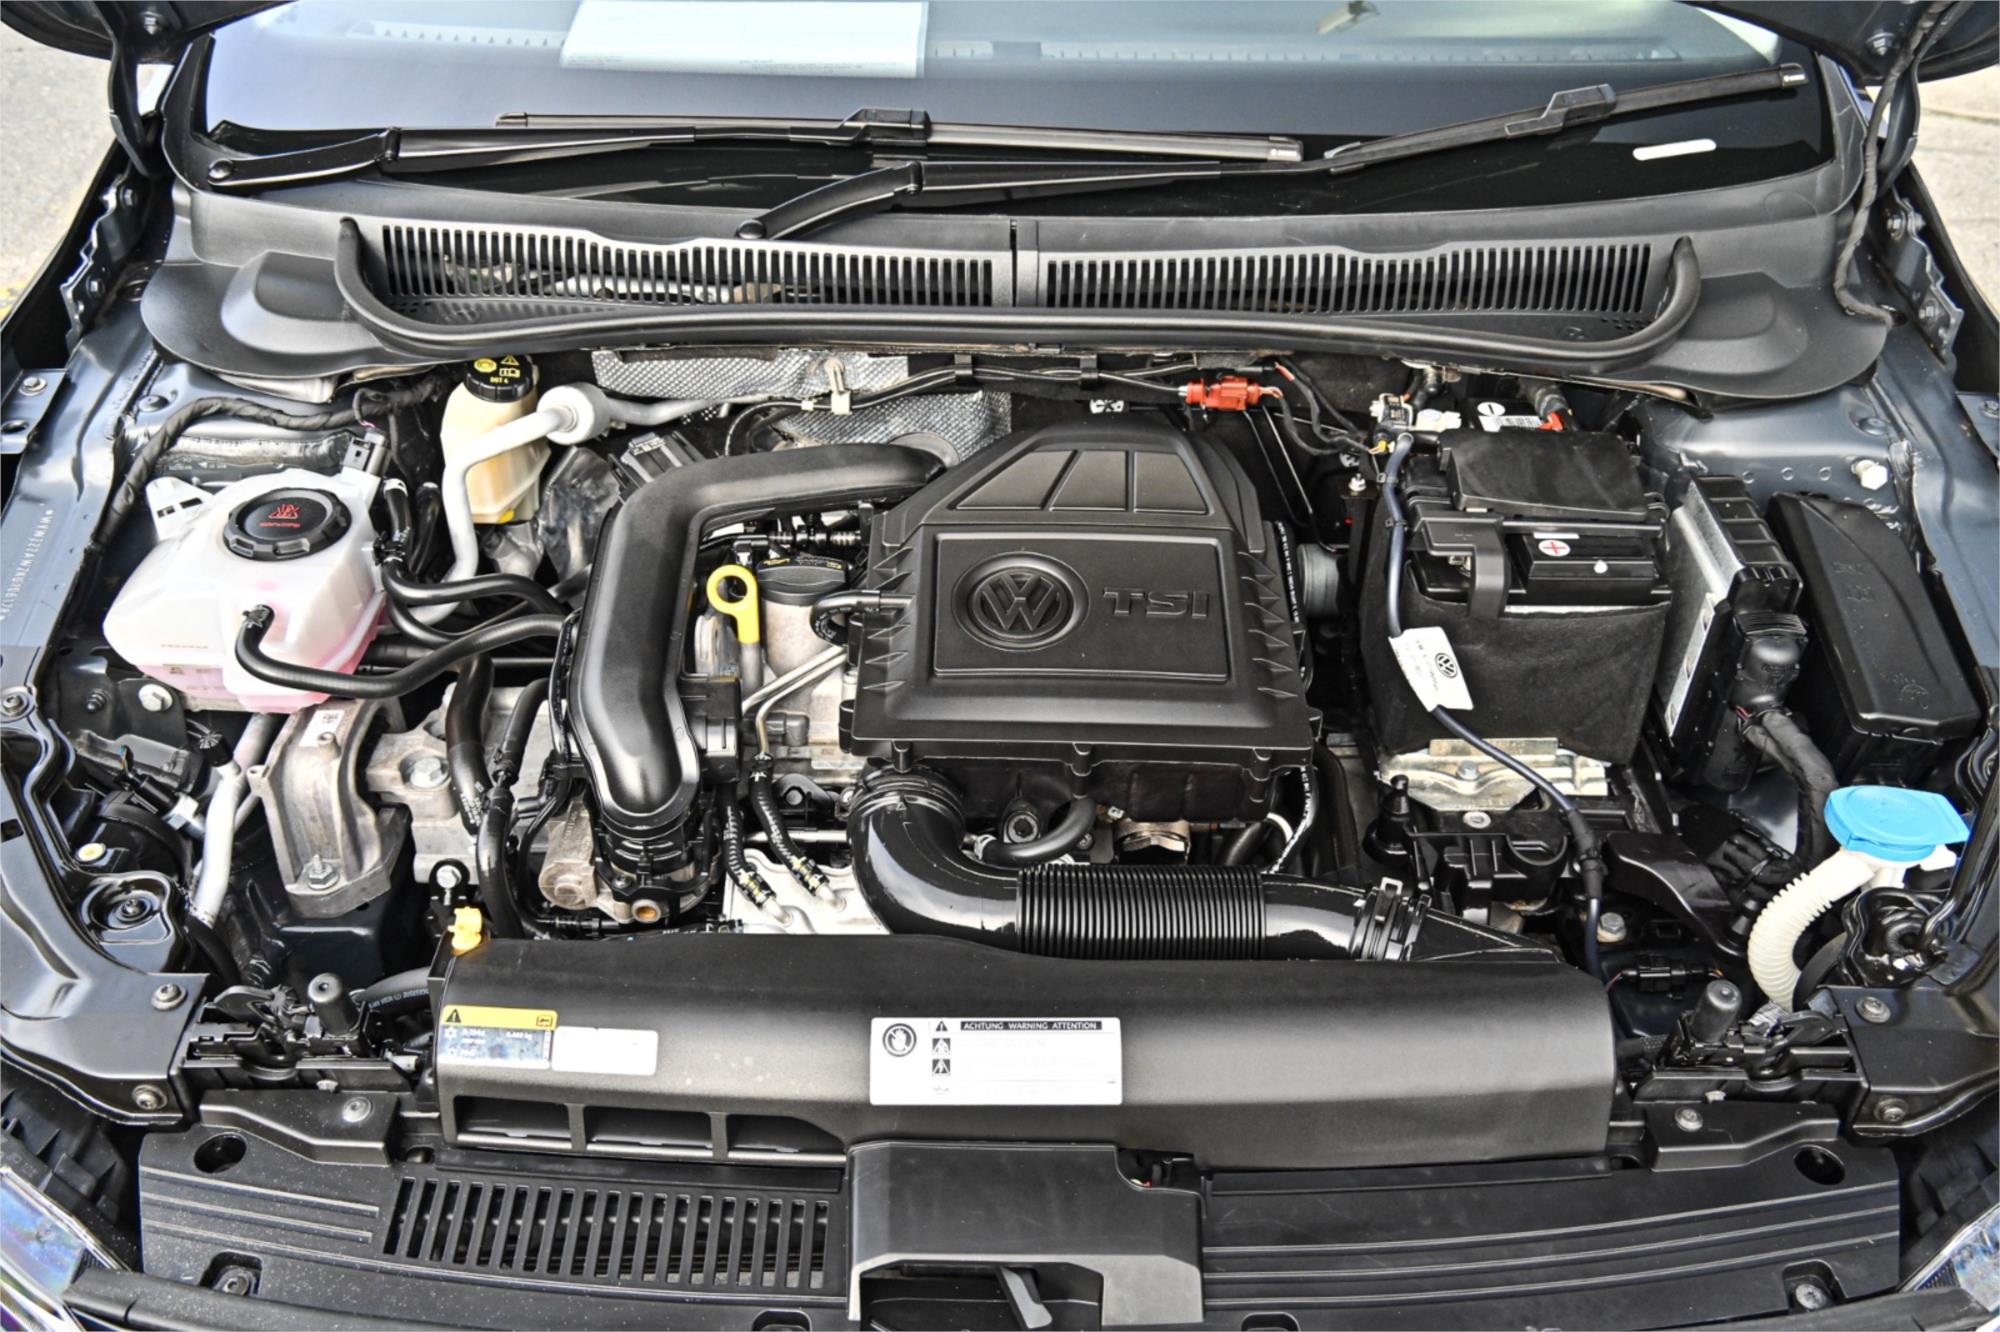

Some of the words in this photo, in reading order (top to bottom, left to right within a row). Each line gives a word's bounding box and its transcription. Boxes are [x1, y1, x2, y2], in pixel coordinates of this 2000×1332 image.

[1103, 586, 1210, 619] TSI
[963, 1021, 1004, 1030] ACHTUNG
[1008, 1021, 1048, 1030] WARNING
[1051, 1021, 1097, 1030] ATTENTION
